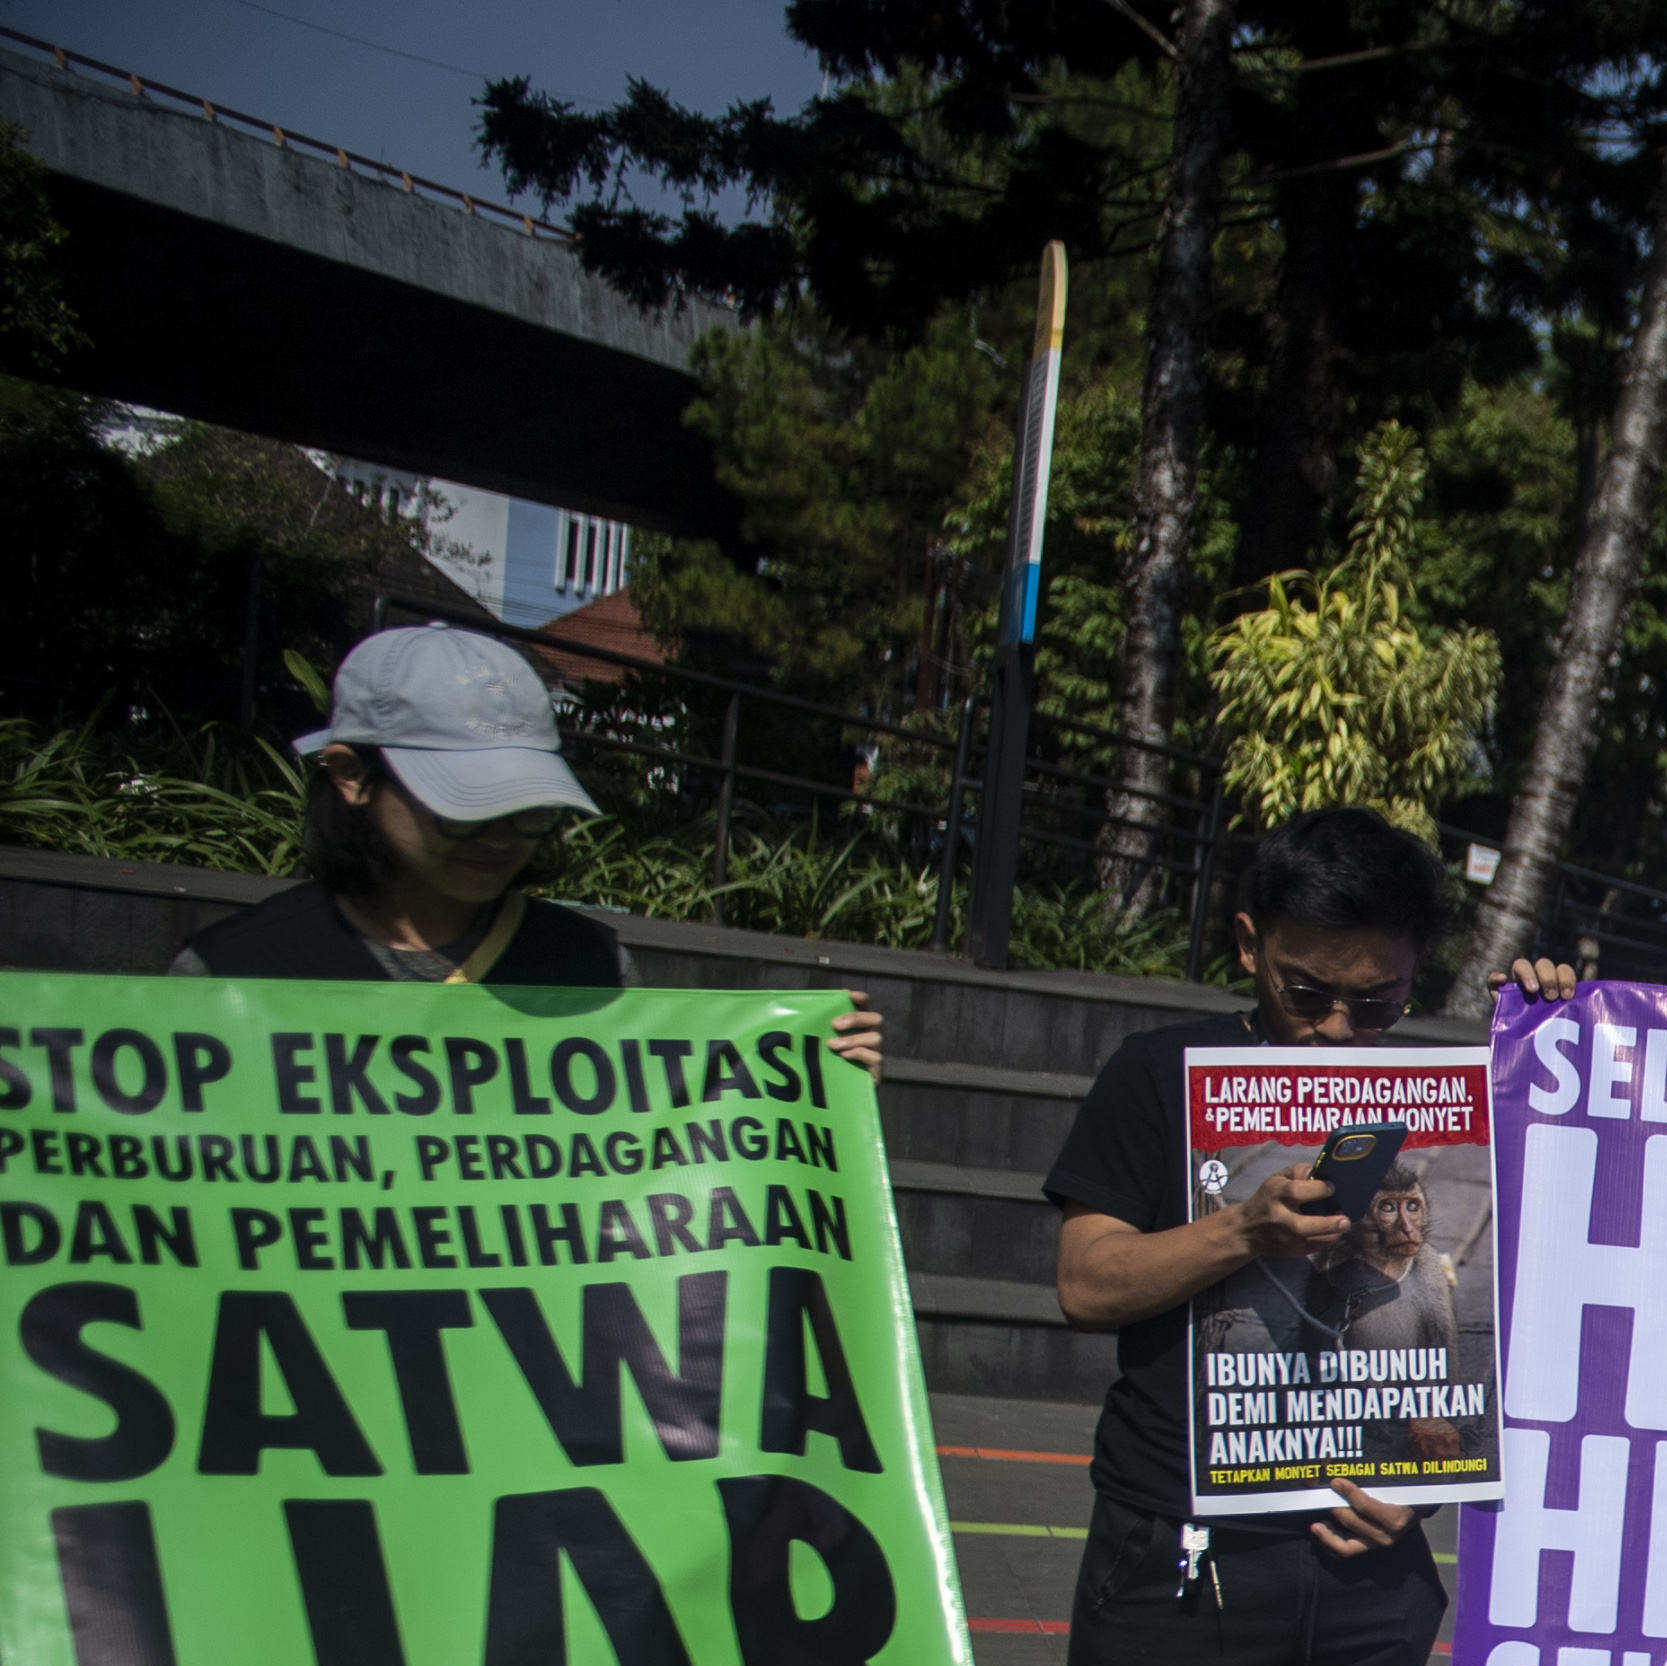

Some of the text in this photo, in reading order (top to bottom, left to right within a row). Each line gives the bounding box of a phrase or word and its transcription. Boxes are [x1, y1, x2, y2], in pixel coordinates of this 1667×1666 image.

[0, 1027, 830, 1117] STOP EKSPLOITASI
[1205, 1076, 1292, 1103] LARANG
[1388, 1106, 1474, 1132] MONYET
[0, 1117, 839, 1191] PERBURUAN, PERDAGANGAN
[0, 1185, 854, 1271] DAN PEMELIHARAAN
[19, 1265, 884, 1483] SATWA
[1206, 1348, 1447, 1386] IBUNYA DIBUNUH
[1208, 1383, 1485, 1425] DEMI MENDAPATKAN
[1209, 1426, 1363, 1465] ANAKNYA!!!
[1210, 1458, 1487, 1484] TETAPKAN MONYET SEBAGAI SATWA DILINDUNGI
